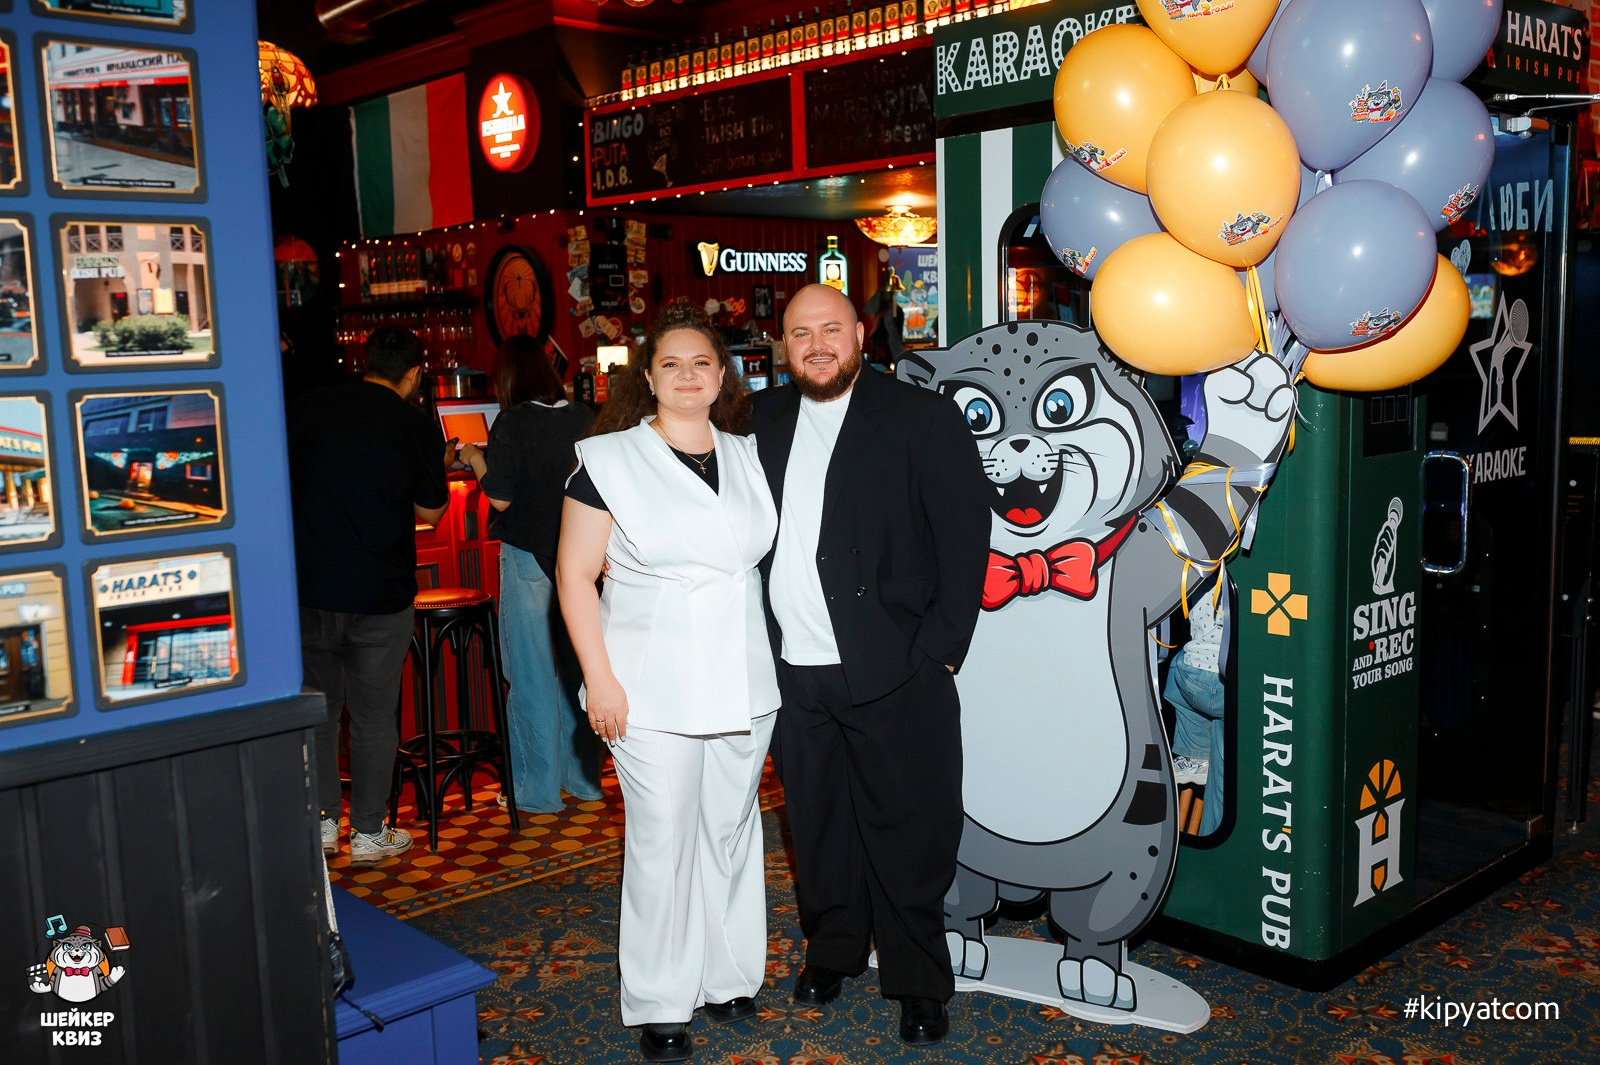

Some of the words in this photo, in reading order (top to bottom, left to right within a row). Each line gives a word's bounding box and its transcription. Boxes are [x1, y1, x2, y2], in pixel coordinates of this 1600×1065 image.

[1201, 3, 1211, 16] 2
[1507, 10, 1582, 60] HARAT'S
[1507, 54, 1549, 77] IRISH
[1558, 67, 1580, 84] PUB
[593, 113, 644, 143] BINGO
[593, 142, 629, 168] PUTA
[720, 248, 806, 273] GUINNESS
[111, 570, 183, 593] HARAT'S
[1353, 592, 1416, 641] SING
[1352, 654, 1373, 671] AND
[1374, 628, 1414, 664] REC
[1352, 667, 1382, 690] YOUR
[1384, 657, 1413, 679] SONG
[1262, 673, 1293, 853] HARAT'S
[1261, 866, 1291, 949] PUB
